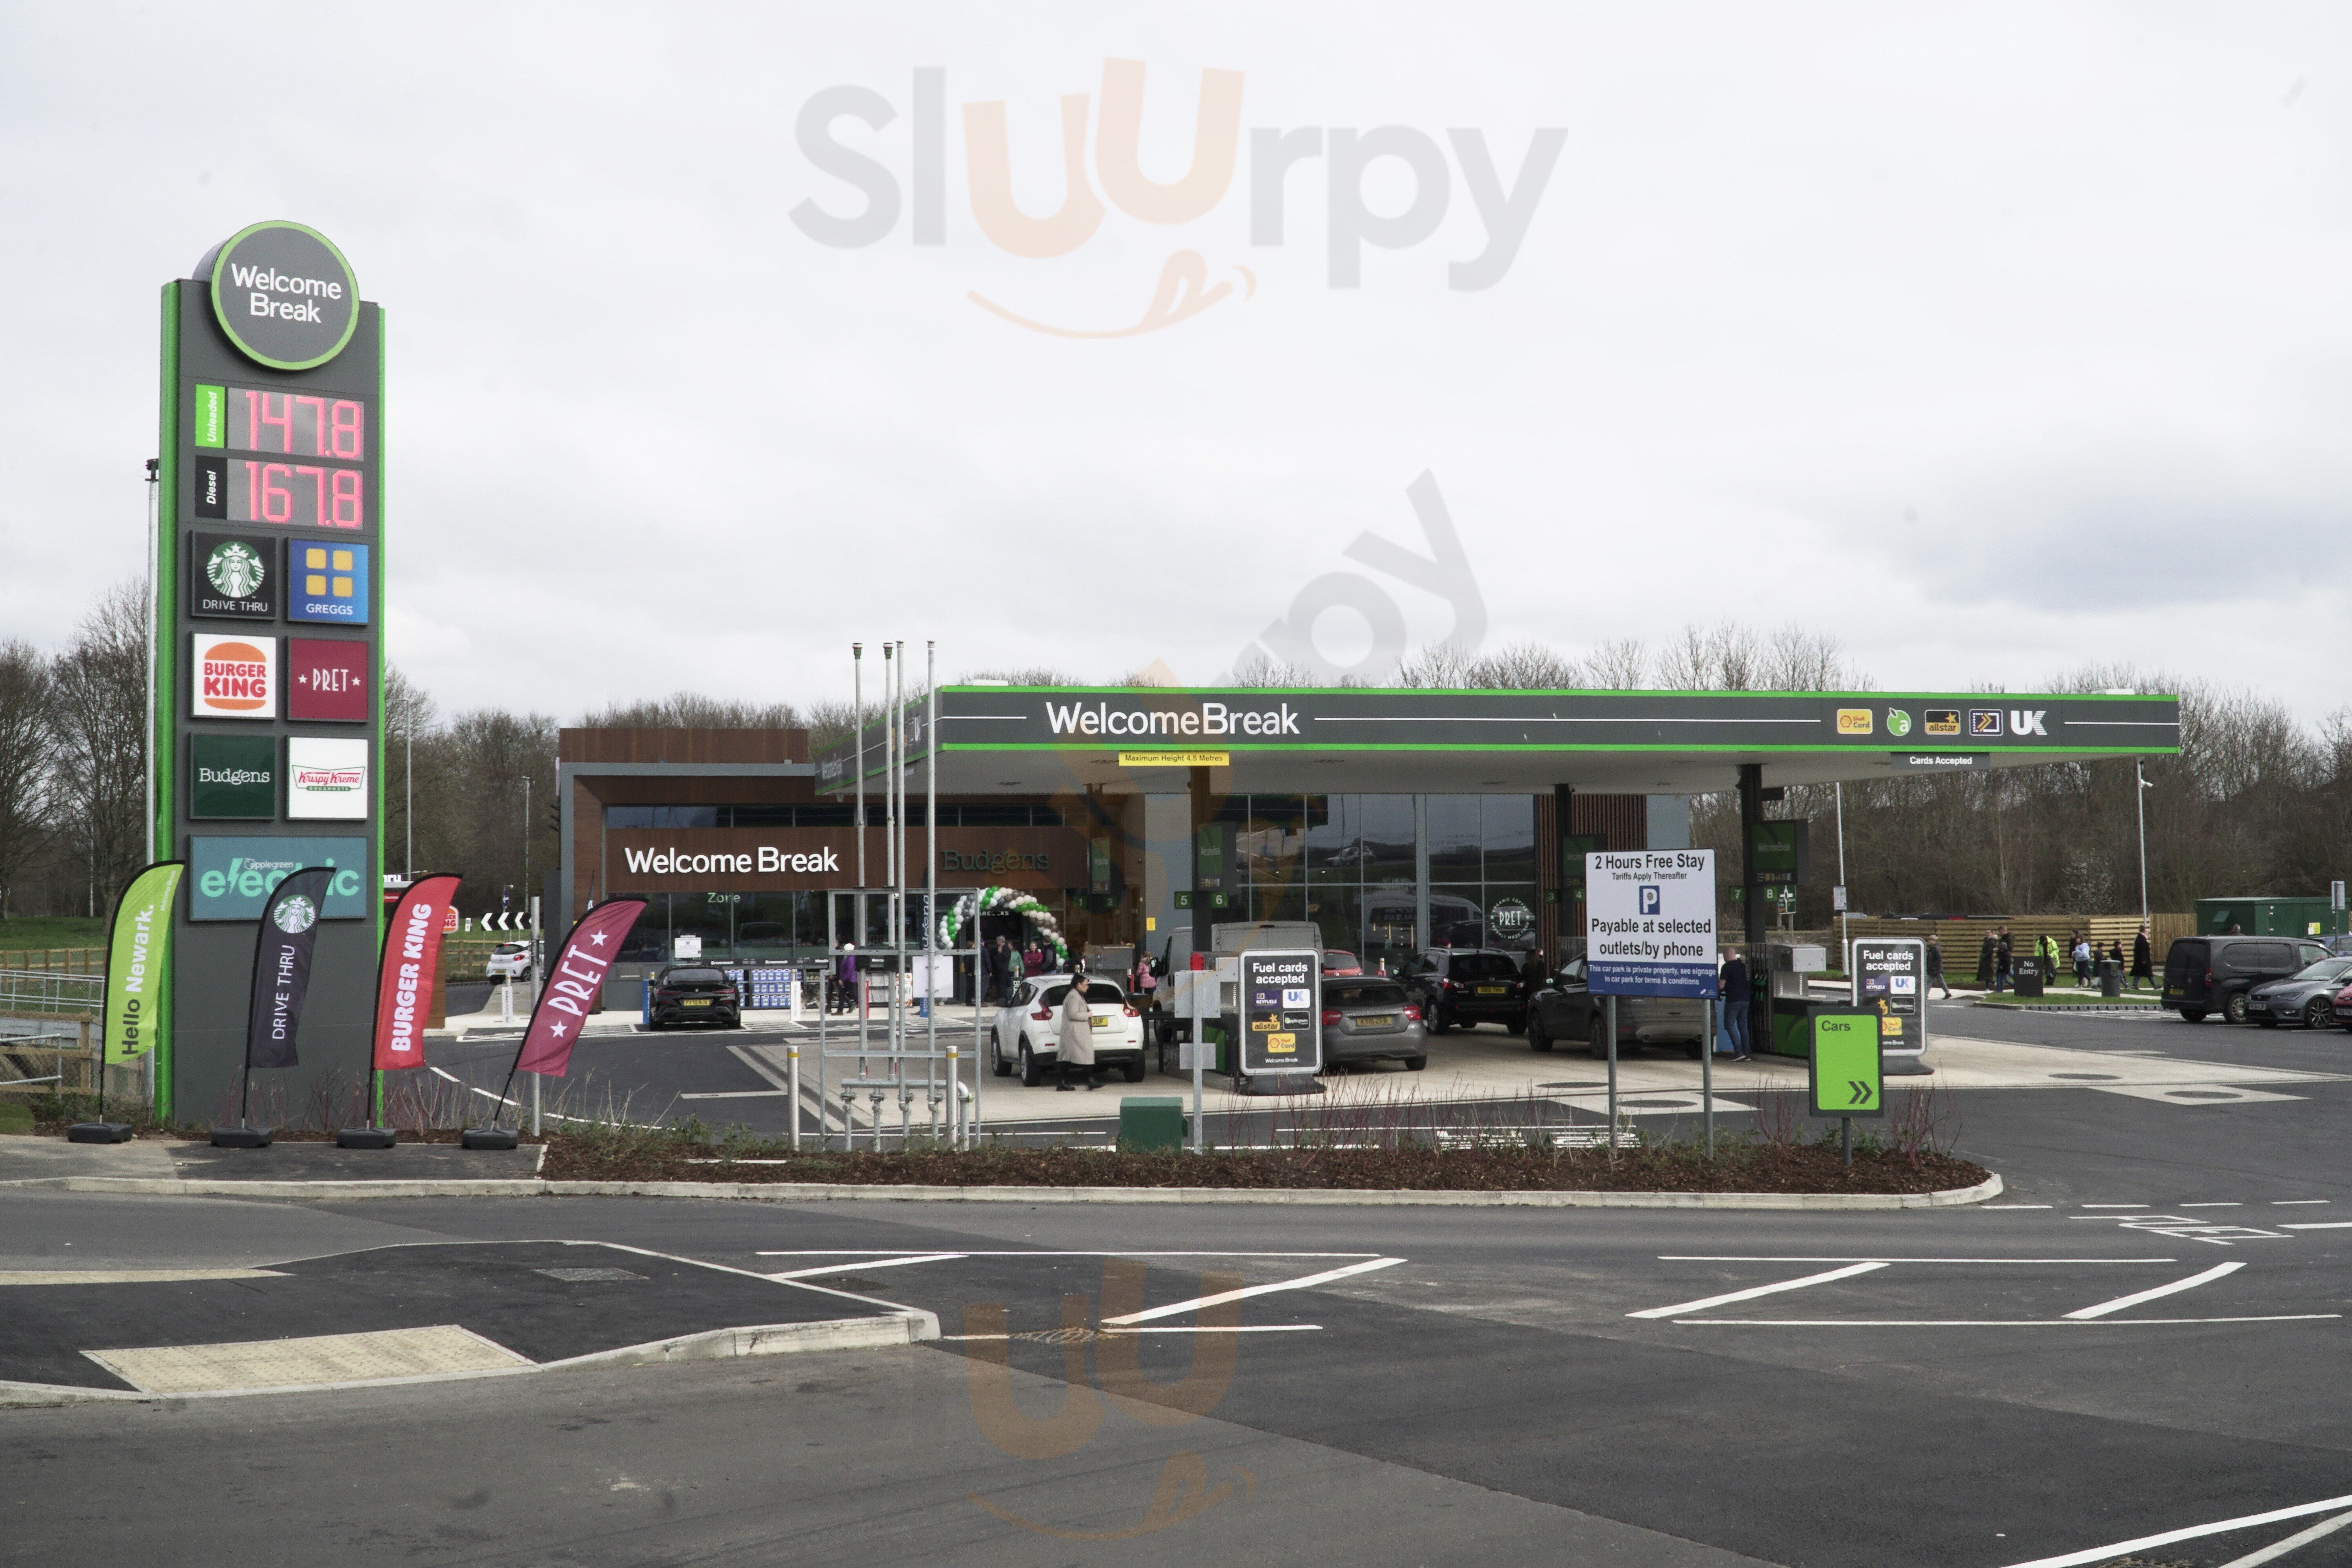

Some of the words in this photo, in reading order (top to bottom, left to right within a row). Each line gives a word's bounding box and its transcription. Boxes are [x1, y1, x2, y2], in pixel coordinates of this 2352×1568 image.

[231, 263, 341, 299] Welcome
[250, 292, 321, 323] Break
[207, 391, 218, 442] Unleaded
[246, 391, 361, 458] 147.8
[206, 470, 217, 504] Diesel
[246, 462, 361, 528] 167.8
[203, 599, 235, 611] DRIVE
[240, 601, 268, 612] THRU
[306, 604, 353, 615] GREGGS
[204, 663, 266, 678] BURGER
[204, 677, 266, 698] KING
[313, 668, 348, 692] PRET
[1929, 723, 1956, 731] allstar
[2011, 710, 2047, 735] UK
[1910, 757, 1933, 766] Cards
[1935, 757, 1972, 766] Accepted
[199, 768, 270, 785] Budgens
[299, 771, 330, 785] Krispy
[330, 772, 361, 784] Kreme
[246, 858, 294, 870] applegreen
[624, 847, 752, 873] Welcome
[758, 846, 839, 873] Break
[941, 849, 1050, 875] Budgens
[1595, 856, 1602, 869] 2
[1606, 855, 1642, 869] Hours
[1646, 854, 1673, 868] Free
[1677, 853, 1705, 871] Stay
[200, 858, 359, 898] elecic
[1633, 872, 1651, 881] Apply
[1078, 898, 1083, 906] 1
[1180, 895, 1187, 905] 5
[1216, 895, 1222, 904] 6
[1643, 888, 1657, 913] P
[1735, 889, 1741, 899] 7
[1767, 889, 1773, 898] 8
[1499, 911, 1521, 926] PRET
[1592, 918, 1639, 936] Payable
[1643, 920, 1654, 933] at
[1658, 918, 1711, 933] selected
[403, 904, 432, 959] KING
[125, 904, 154, 993] Newark.
[1600, 941, 1659, 959] outlets/by
[1664, 942, 1703, 959] phone
[1863, 950, 1884, 960] Fuel
[1887, 951, 1914, 960] cards
[278, 945, 295, 984] THRU
[1253, 962, 1275, 973] Fuel
[1278, 962, 1308, 973] cards
[1612, 965, 1624, 974] park
[1632, 966, 1652, 975] private
[1692, 967, 1716, 976] signage
[1866, 961, 1911, 972] accepted
[547, 944, 607, 1017] PRET
[1256, 973, 1305, 985] accepted
[1621, 976, 1633, 984] park
[1668, 977, 1699, 985] conditions
[1895, 978, 1910, 988] UK
[1288, 991, 1303, 1001] UK
[392, 963, 419, 1051] BURGER
[272, 993, 289, 1040] DRIVE
[122, 999, 141, 1055] Hello
[1822, 1020, 1850, 1033] Cars
[2068, 1215, 2295, 1245] FUEL
